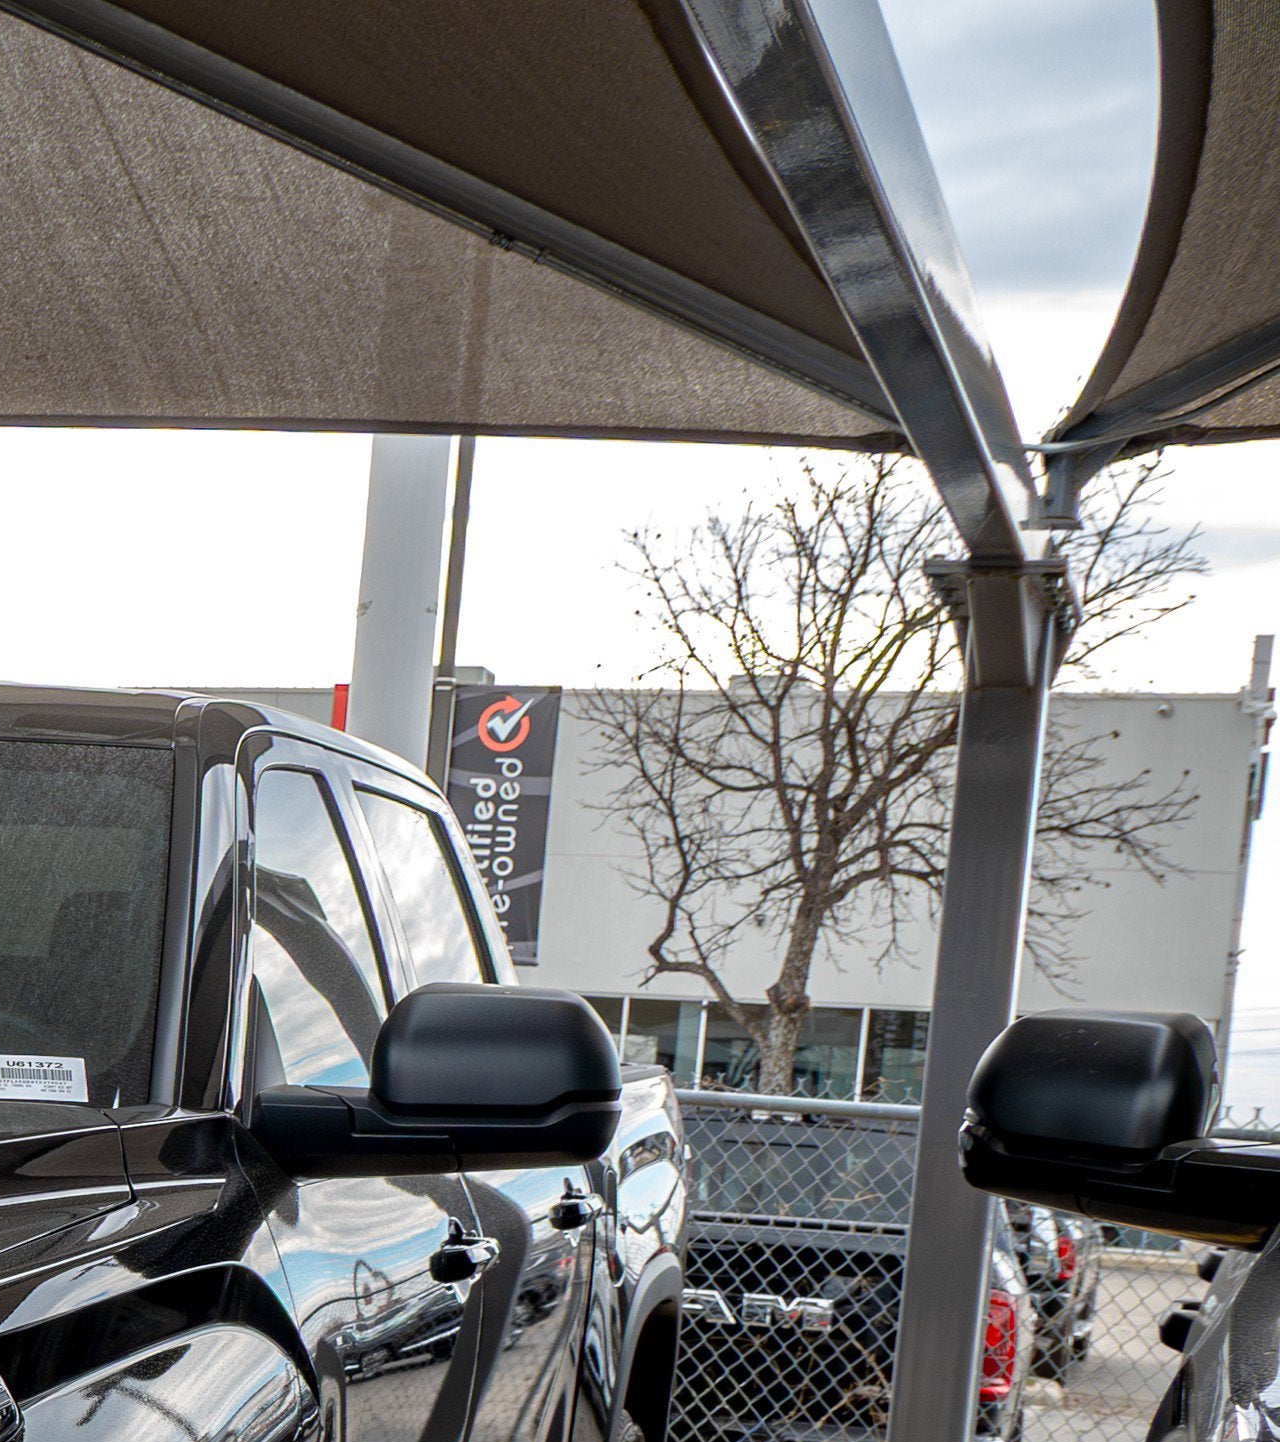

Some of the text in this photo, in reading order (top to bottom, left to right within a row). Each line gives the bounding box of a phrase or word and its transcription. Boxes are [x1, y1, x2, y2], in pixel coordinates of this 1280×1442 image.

[466, 777, 497, 884] tified
[491, 757, 523, 950] e-owned
[6, 1060, 64, 1069] U61372
[681, 1287, 834, 1332] AM
